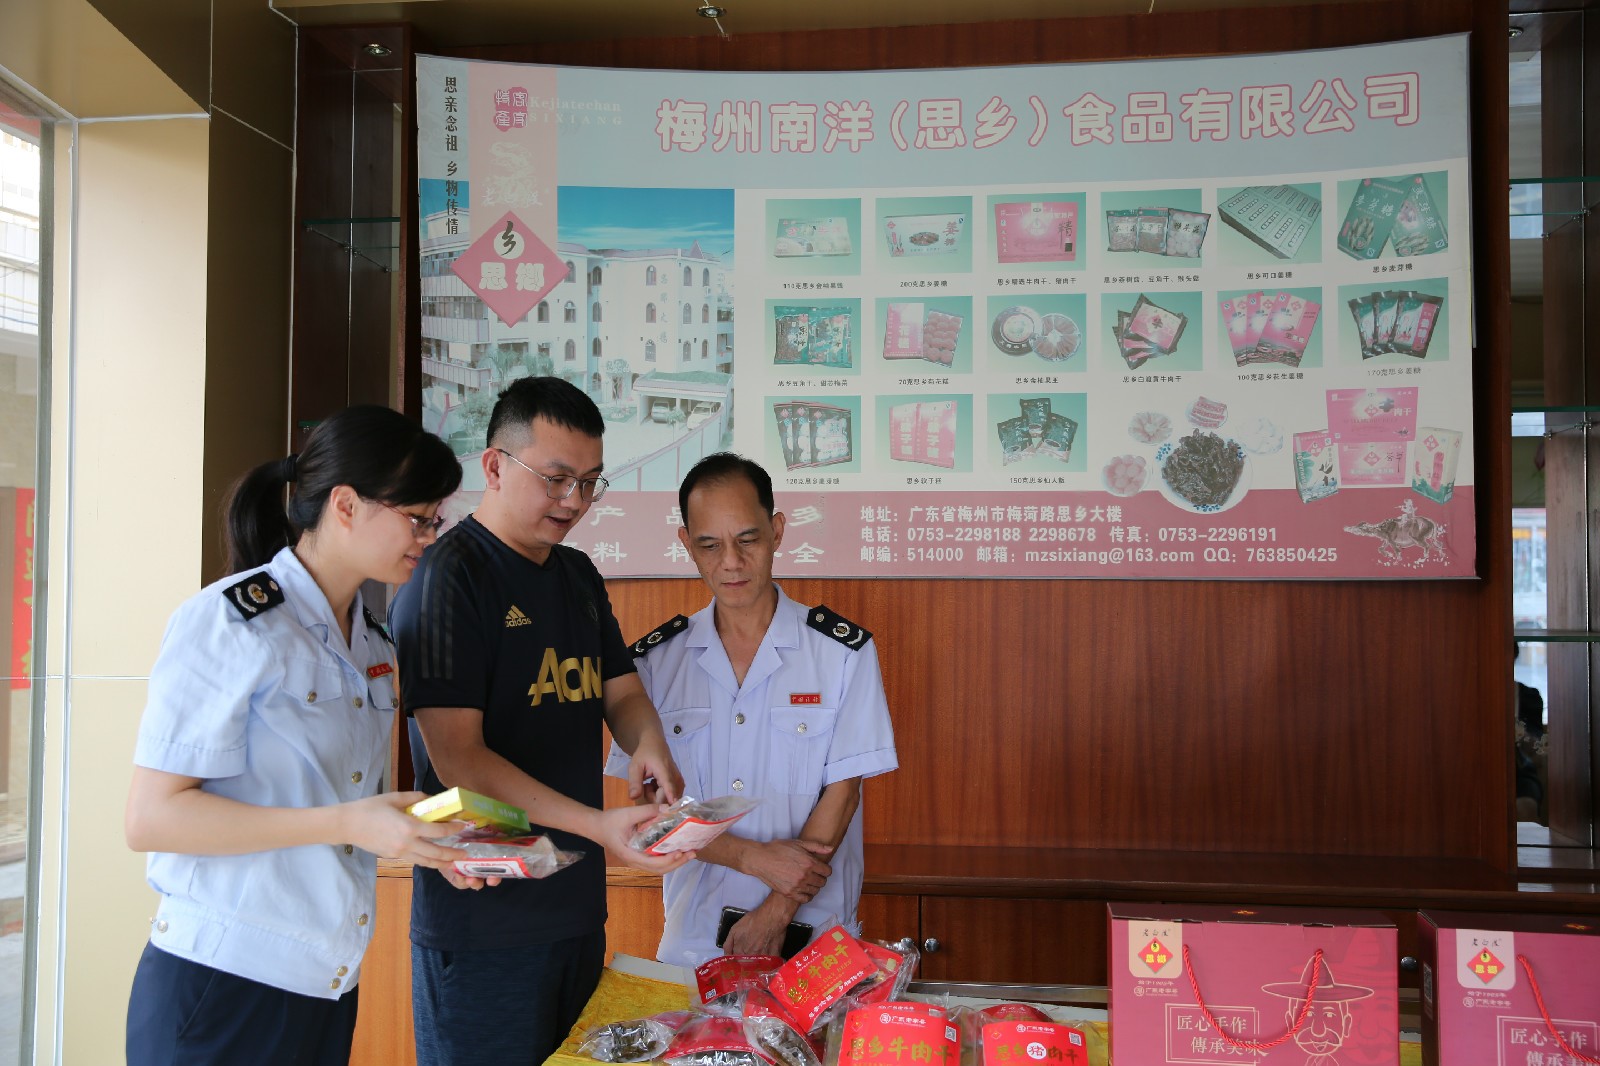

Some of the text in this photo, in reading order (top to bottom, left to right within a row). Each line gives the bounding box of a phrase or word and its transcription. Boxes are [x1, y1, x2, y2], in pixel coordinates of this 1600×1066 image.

[531, 97, 622, 111] Kejiatechan
[656, 72, 1419, 153] 梅州南洋（思乡）食品有限公司
[444, 76, 458, 235] 思亲念祖 乡物传情
[860, 505, 898, 523] 地址：
[860, 525, 1277, 543] 电话： 0753-2298188 2298678 传真： 0753-2296191
[860, 546, 898, 563] 邮编：
[907, 548, 964, 562] 514000
[976, 546, 1015, 563] 邮箱：
[1025, 548, 1195, 565] mzsixiang@163.com
[1246, 548, 1338, 562] 763850425
[505, 617, 532, 628] adidas
[1177, 1015, 1247, 1034] 匠心手作
